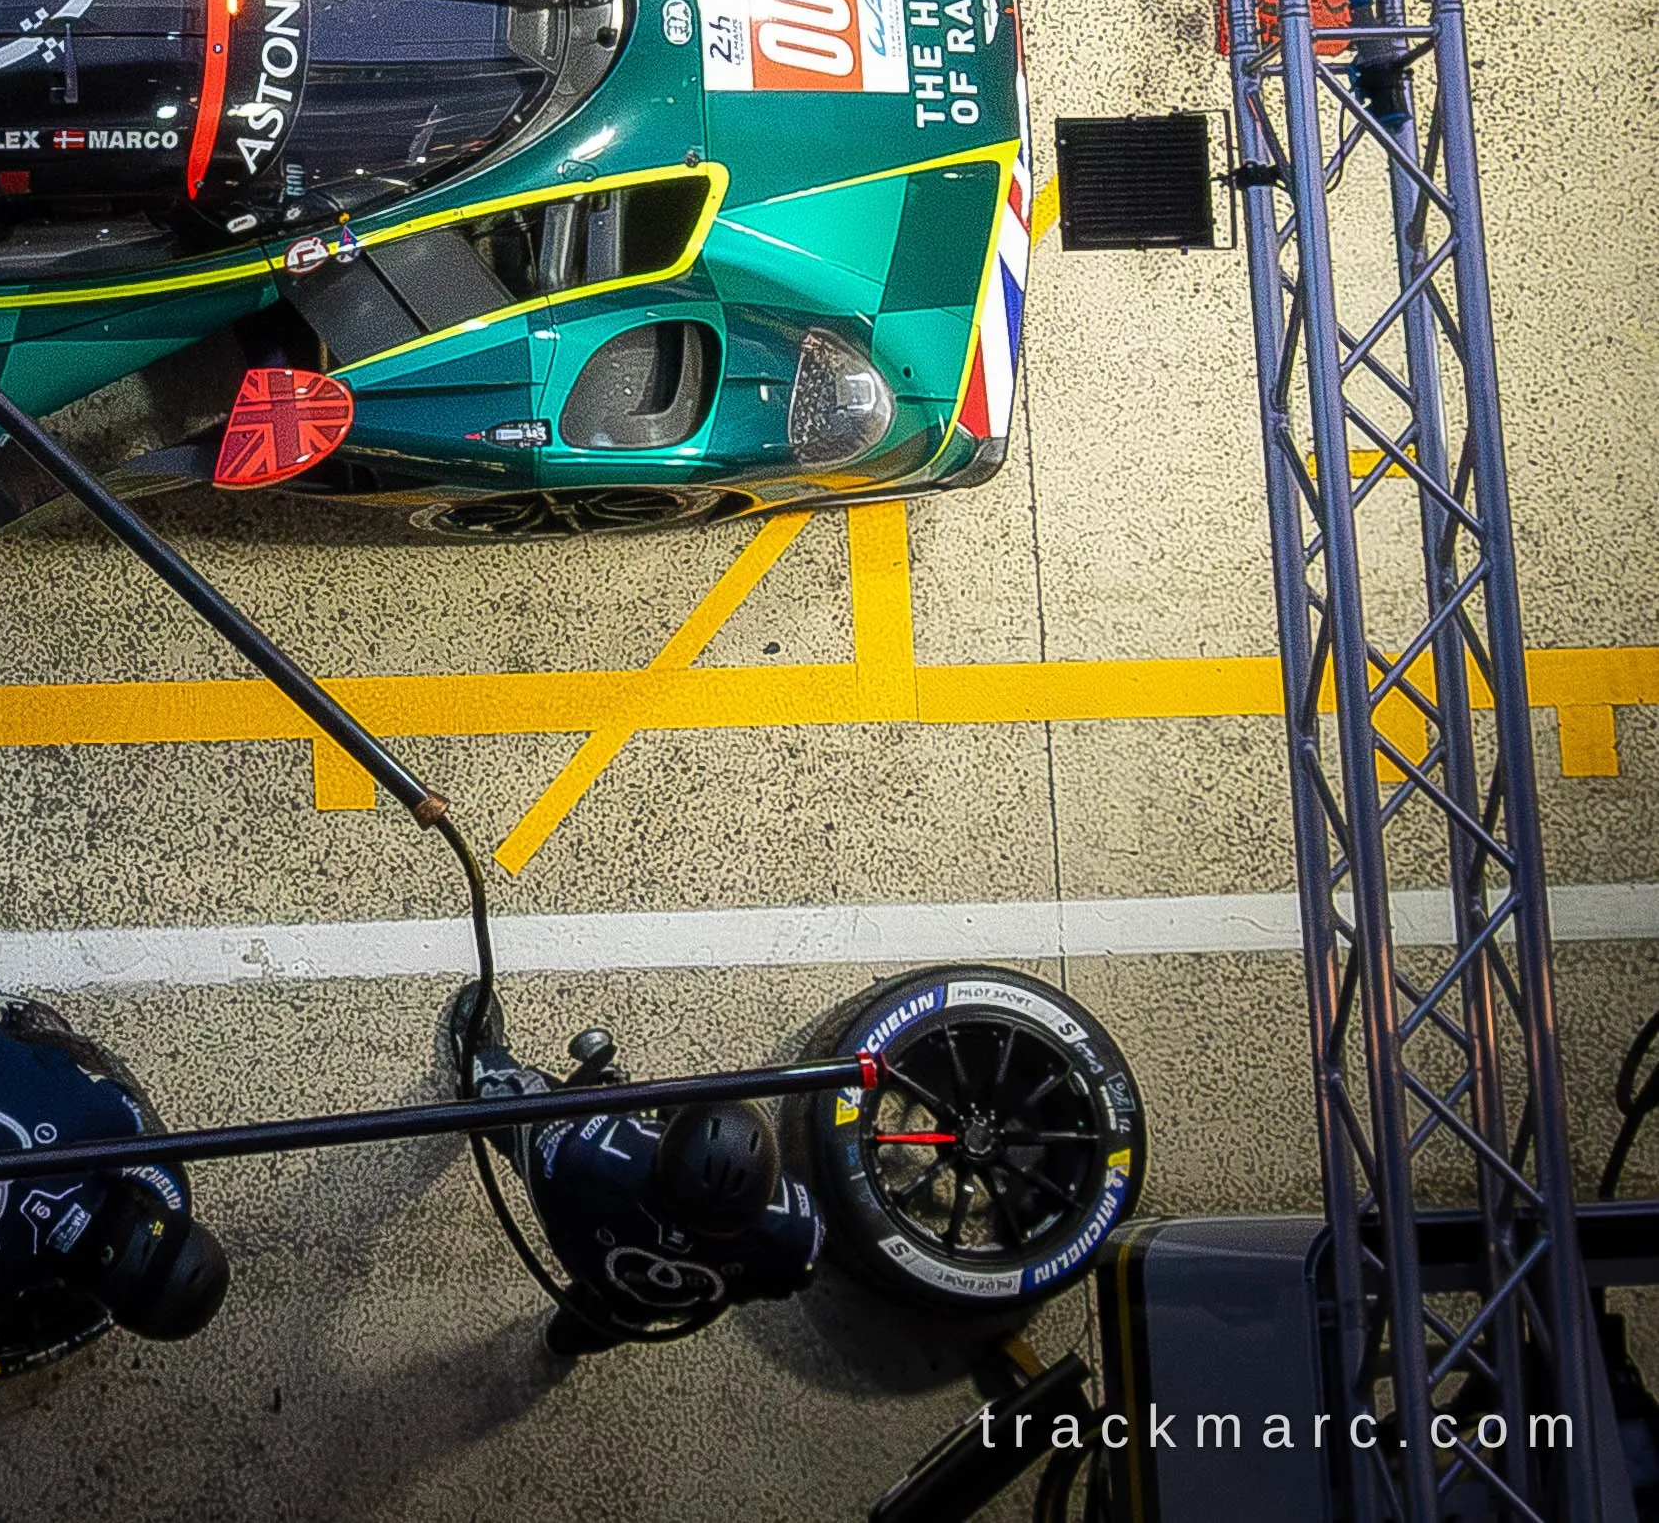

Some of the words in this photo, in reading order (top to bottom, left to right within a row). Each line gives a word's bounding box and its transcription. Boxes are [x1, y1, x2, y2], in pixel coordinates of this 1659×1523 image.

[914, 44, 946, 128] THE
[948, 70, 980, 125] OF
[88, 130, 179, 150] MARCO
[1058, 1022, 1076, 1038] S
[1034, 1192, 1118, 1285] MICHELIN
